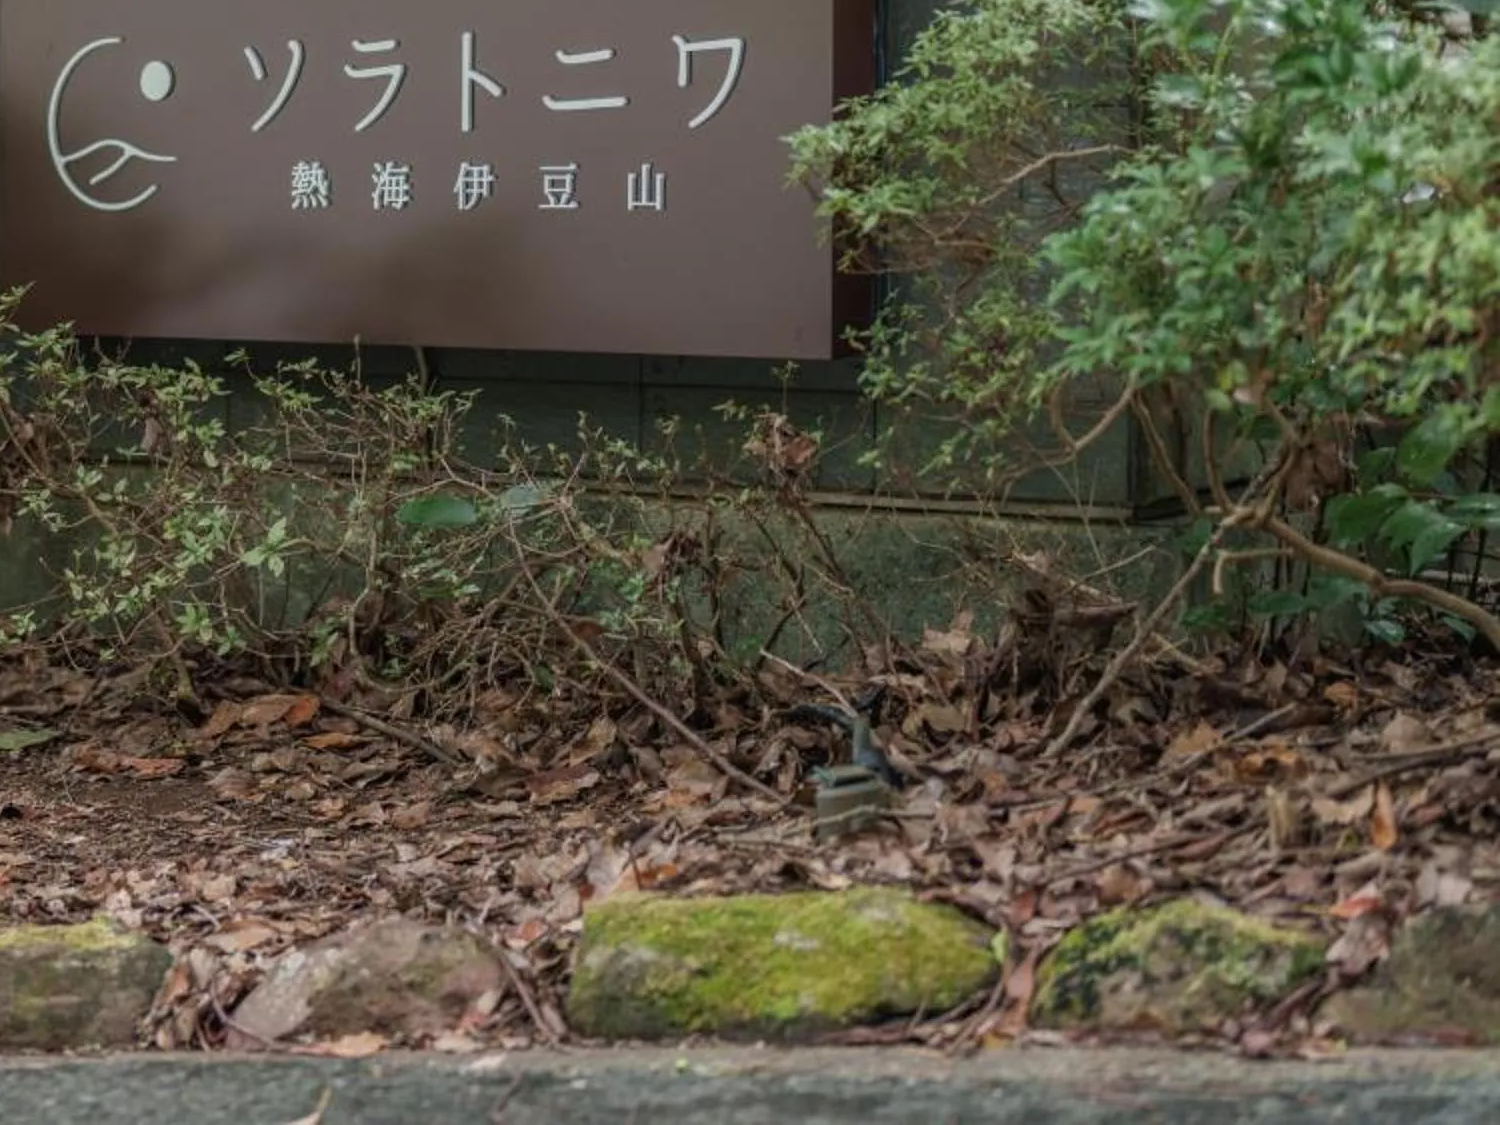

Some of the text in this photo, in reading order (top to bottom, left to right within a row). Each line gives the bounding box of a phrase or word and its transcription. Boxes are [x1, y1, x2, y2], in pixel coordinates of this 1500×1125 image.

[242, 30, 746, 133] ソラトニワ
[289, 161, 668, 212] 熱海伊豆山
